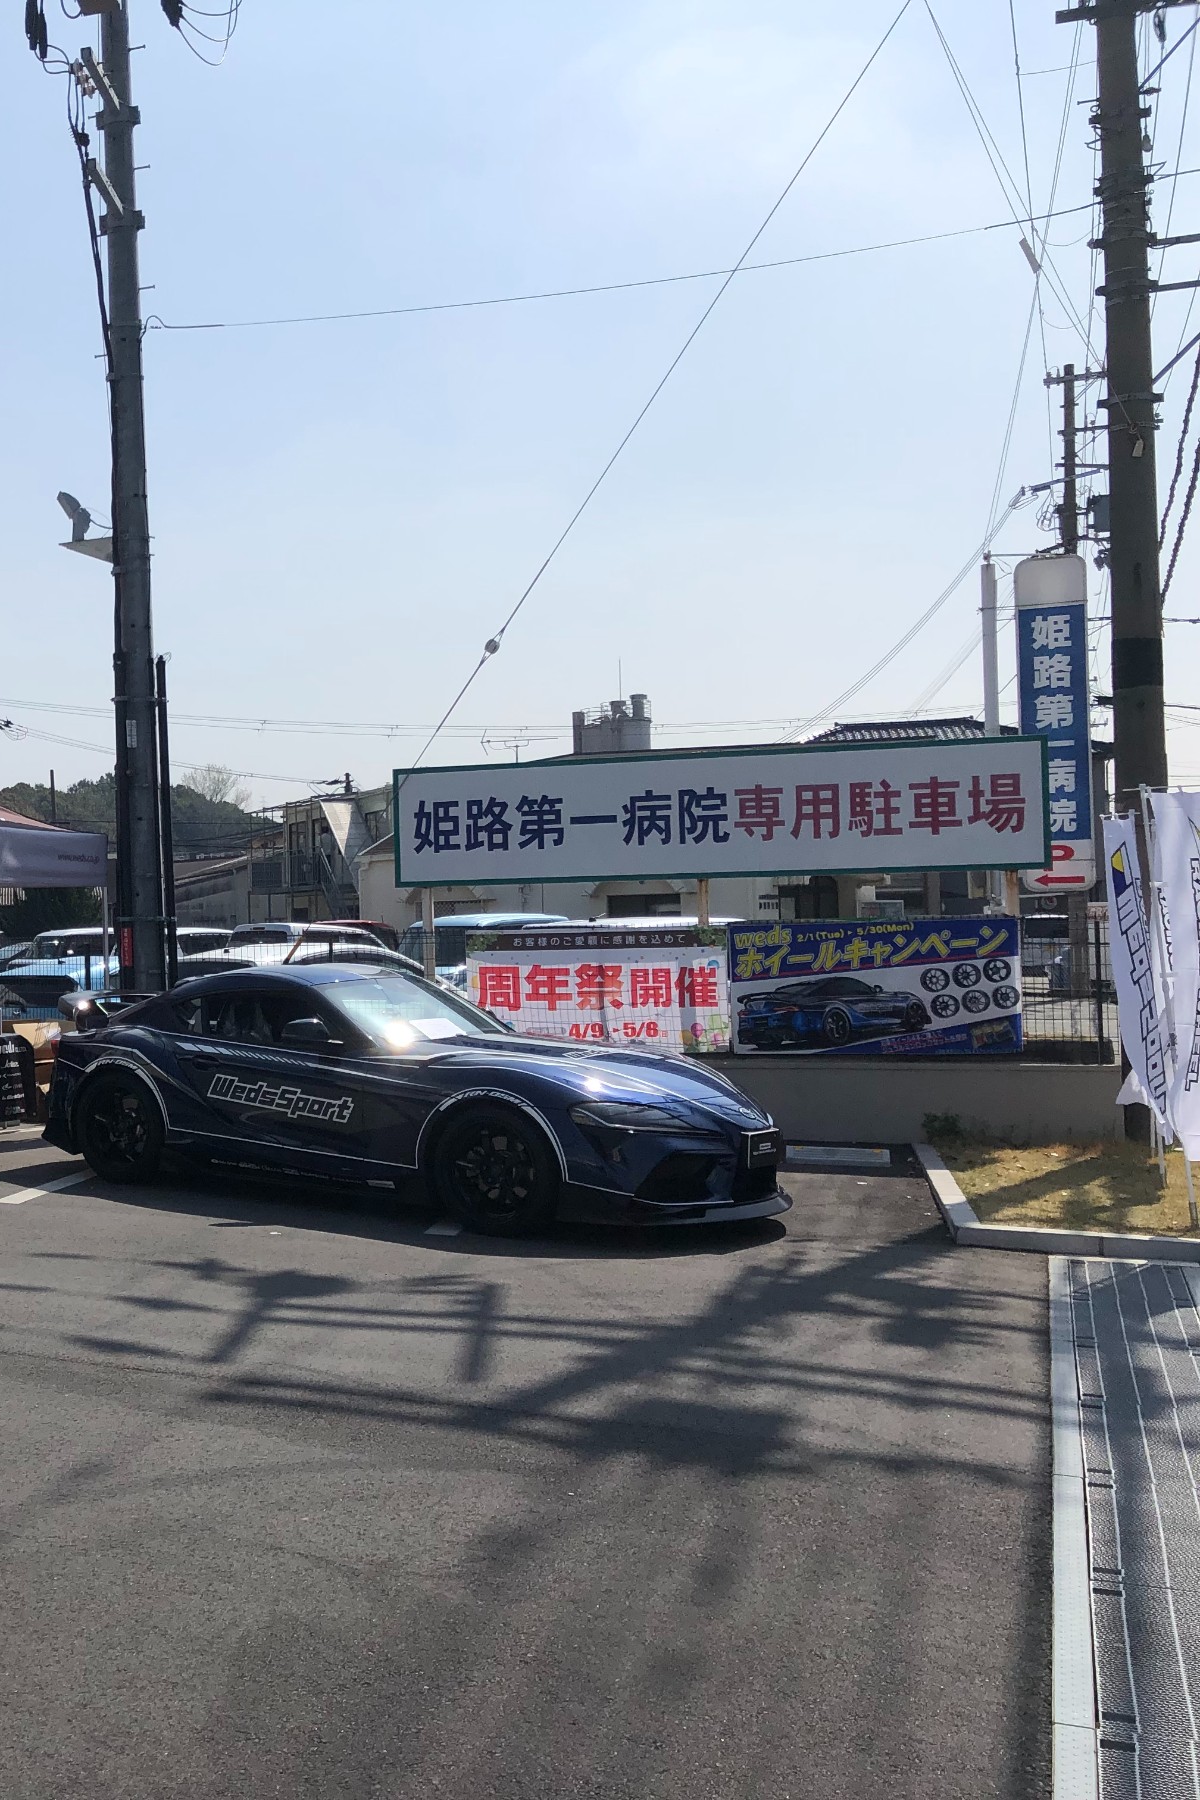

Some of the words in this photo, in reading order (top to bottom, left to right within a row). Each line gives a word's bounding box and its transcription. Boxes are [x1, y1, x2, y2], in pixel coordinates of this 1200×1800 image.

[1031, 613, 1077, 833] 姫路第一病院
[412, 772, 1028, 855] 姫路第一病院専用駐車場
[1044, 844, 1076, 872] P
[513, 934, 686, 947] お客様のご愛顧に感謝を込めて
[734, 924, 792, 948] weds
[734, 926, 1009, 978] ホイールキャンペーン
[476, 964, 720, 1012] 周年祭開催
[568, 1022, 604, 1039] 4/9
[623, 1022, 659, 1038] 5/8
[207, 1074, 355, 1123] WedsSport
